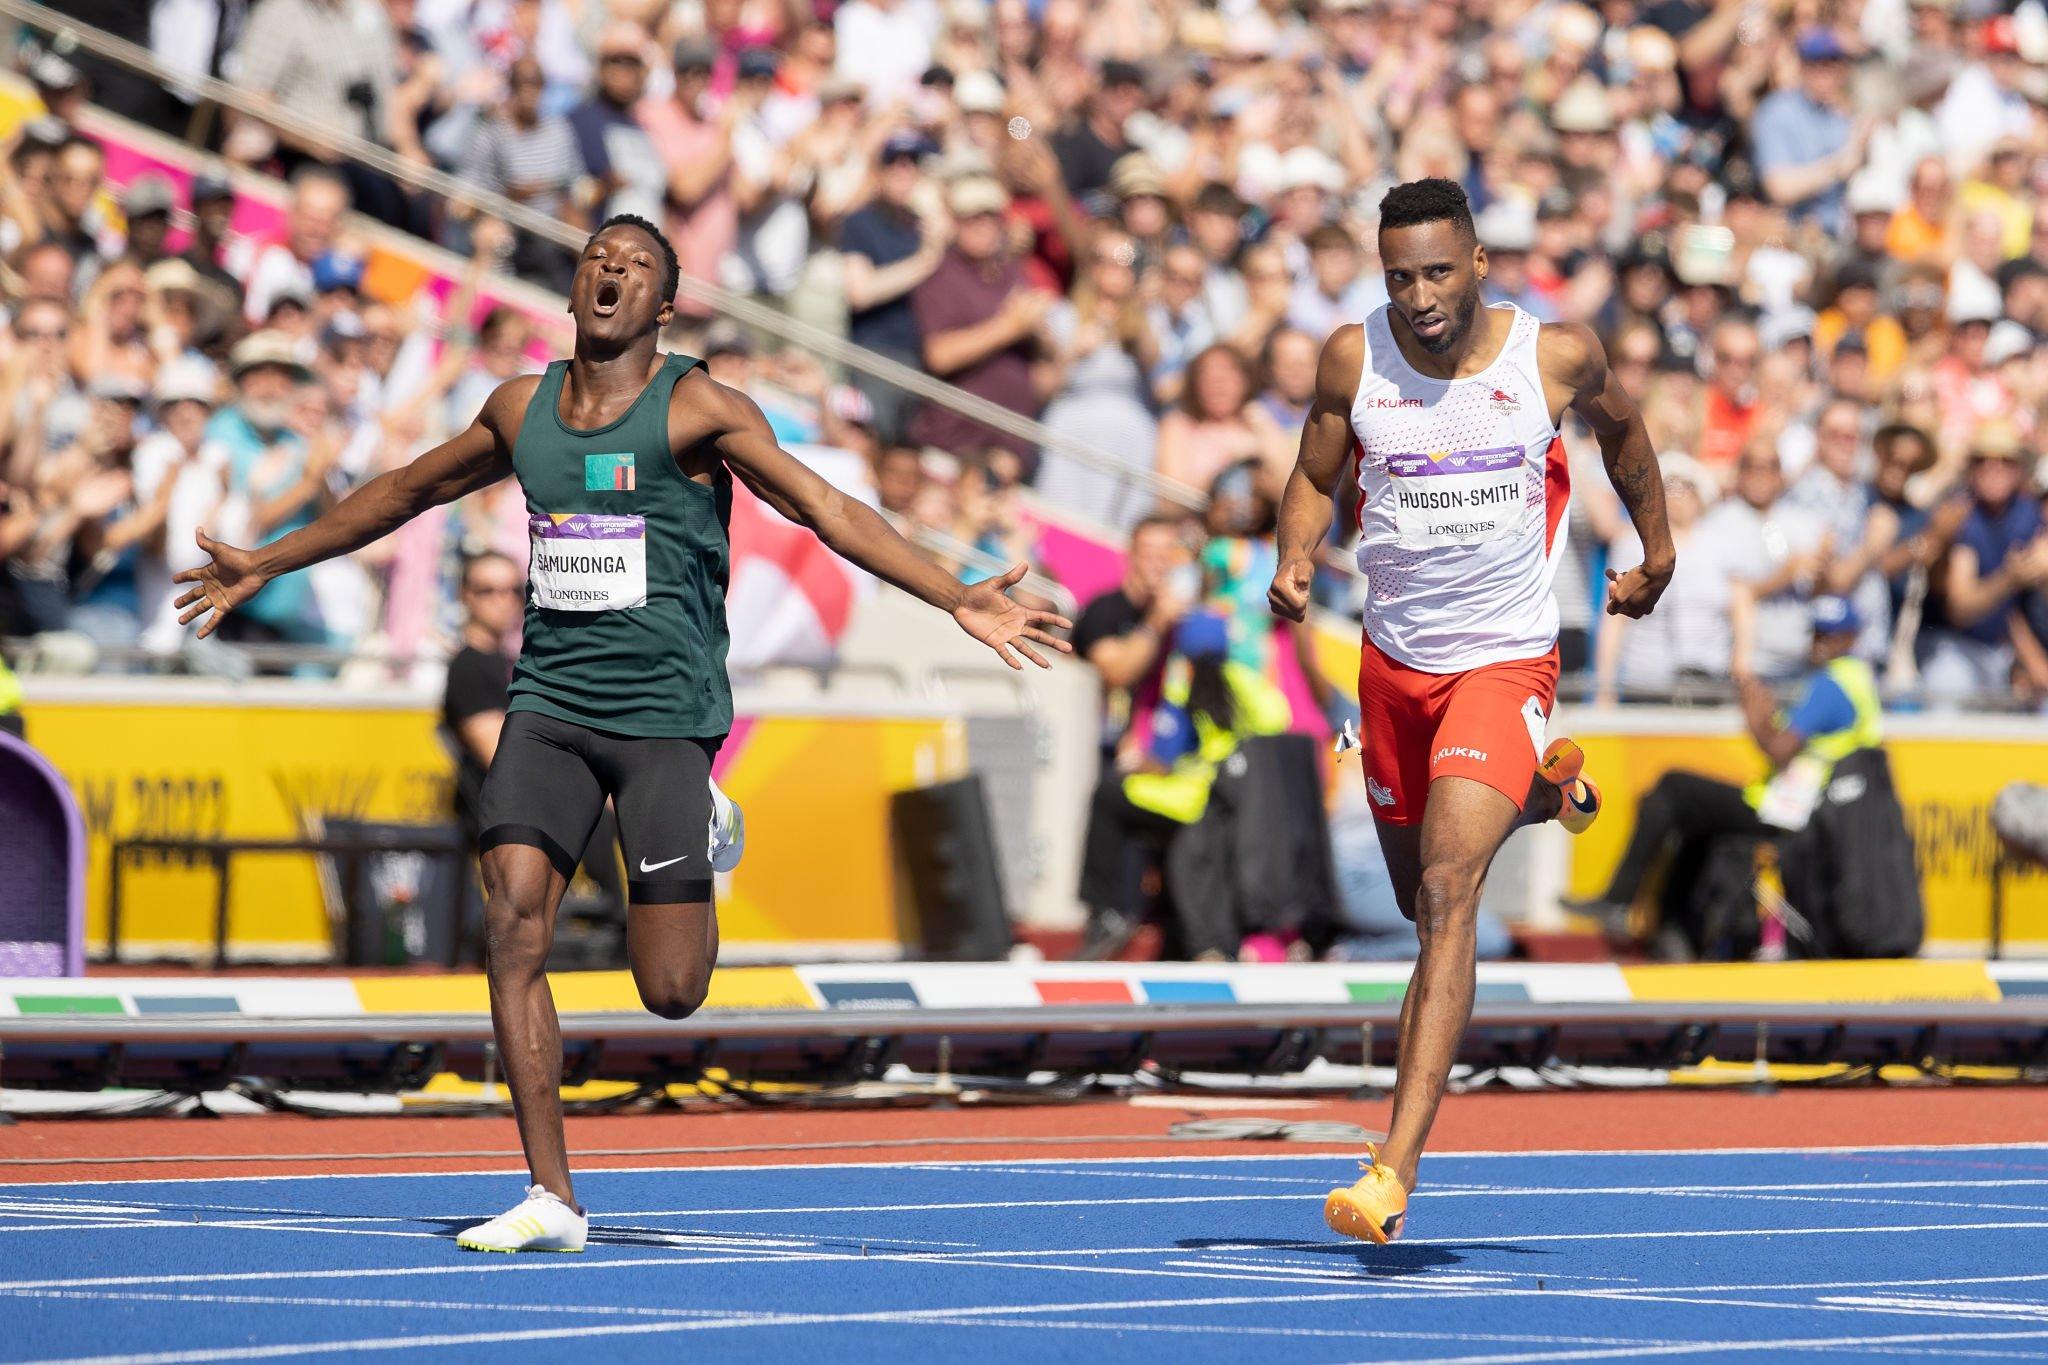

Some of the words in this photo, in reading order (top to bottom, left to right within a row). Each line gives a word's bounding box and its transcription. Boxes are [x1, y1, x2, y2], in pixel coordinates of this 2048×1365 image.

[1377, 398, 1424, 409] KUKRI
[1399, 482, 1520, 510] HUDSON-SMITH
[1428, 520, 1496, 535] LONGINES
[537, 553, 627, 574] SAMUKONGA
[550, 588, 610, 601] LONGINES
[1437, 746, 1488, 762] KUKRI
